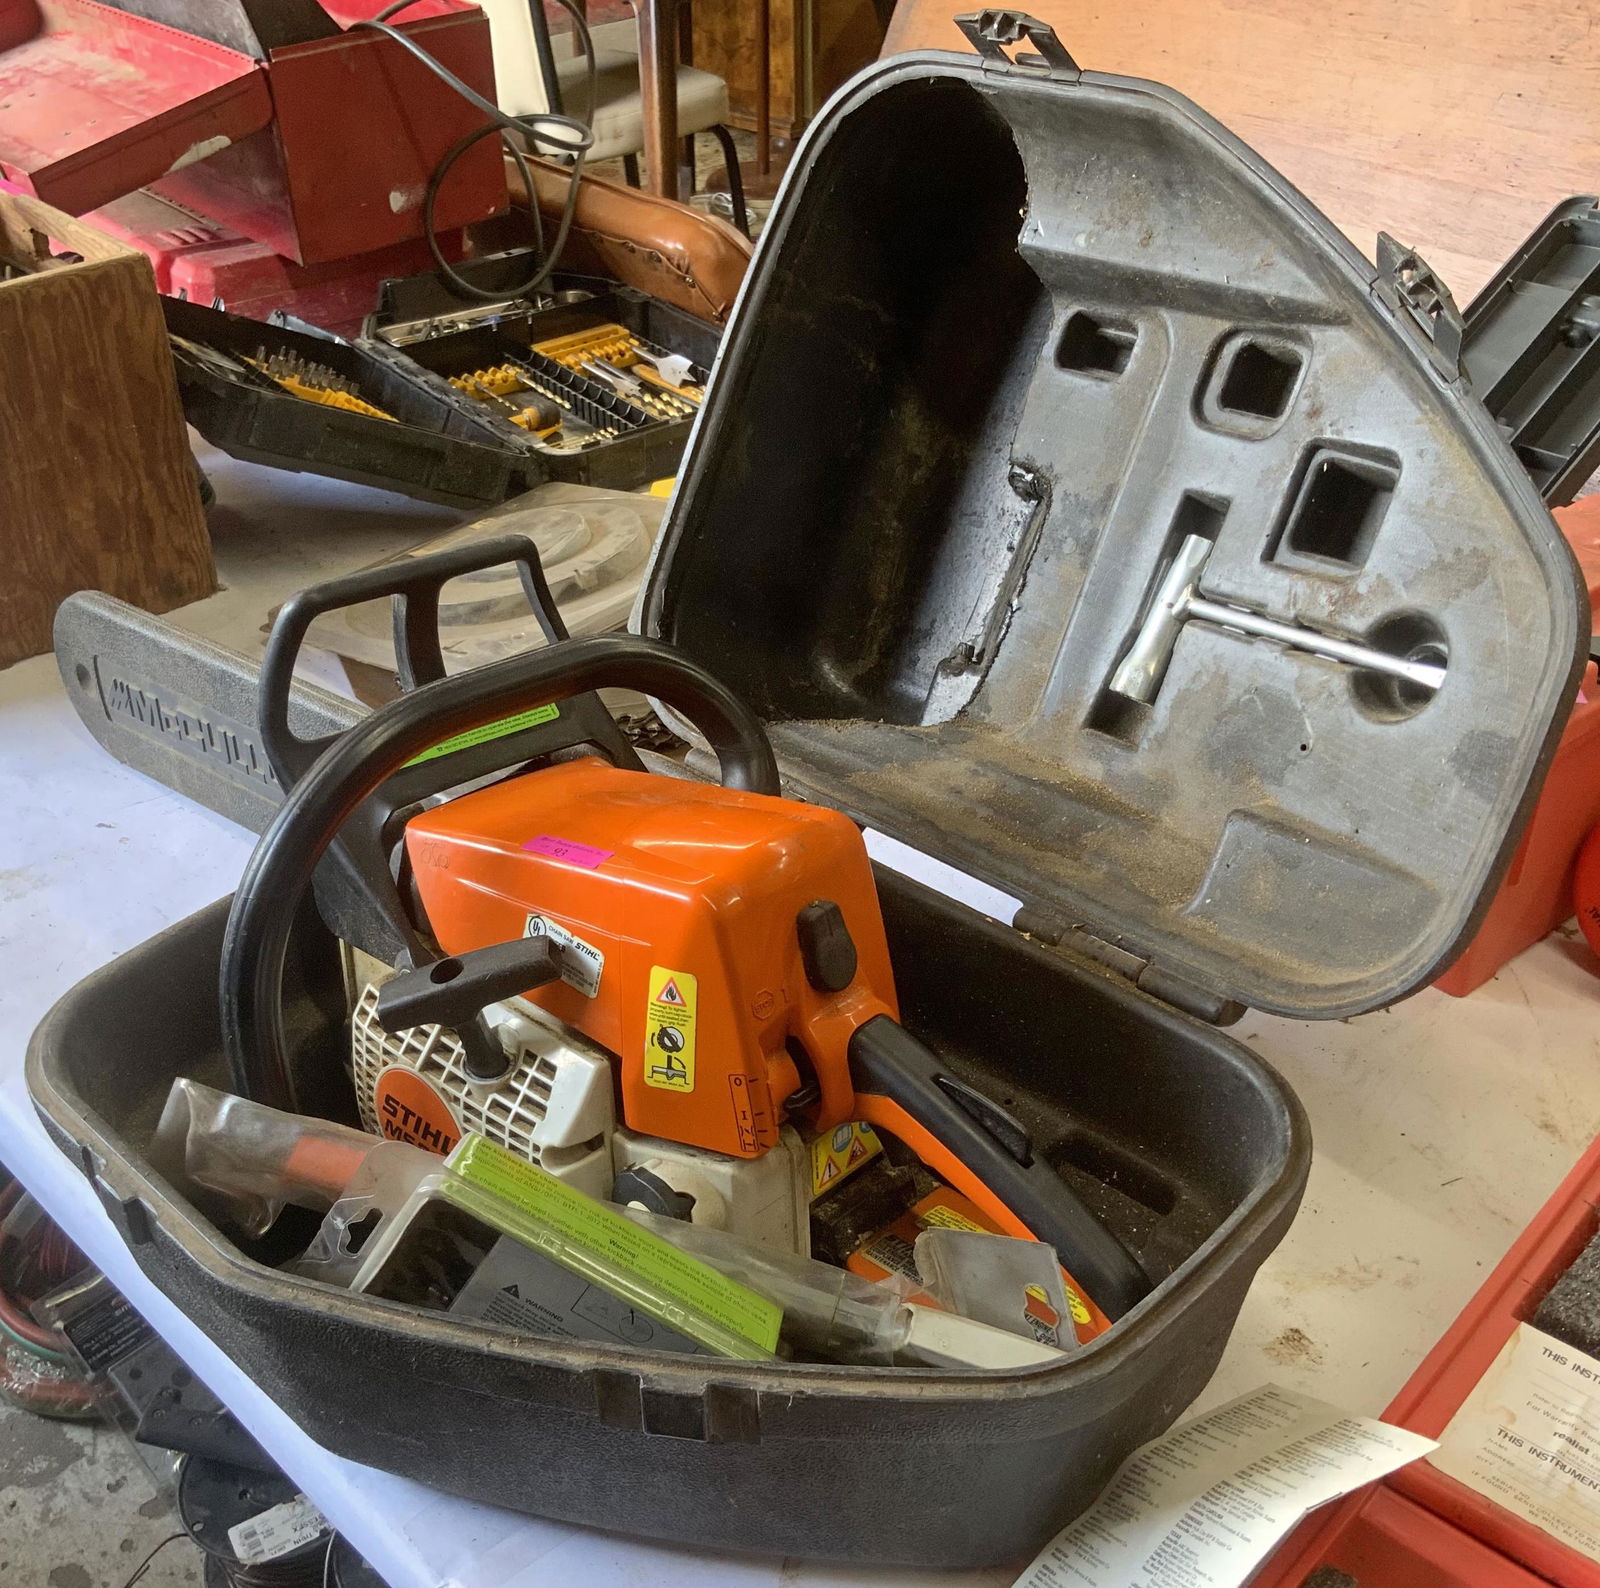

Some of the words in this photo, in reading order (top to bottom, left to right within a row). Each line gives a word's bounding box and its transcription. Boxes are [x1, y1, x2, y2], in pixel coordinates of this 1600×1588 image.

[575, 942, 599, 961] STIHL
[382, 1093, 450, 1155] STIHL
[606, 1238, 639, 1260] Warning!
[525, 1297, 564, 1323] WARNING
[1542, 1346, 1569, 1368] THIS
[1572, 1362, 1600, 1386] INST
[1497, 1427, 1524, 1449] THIS
[1552, 1431, 1590, 1455] realist
